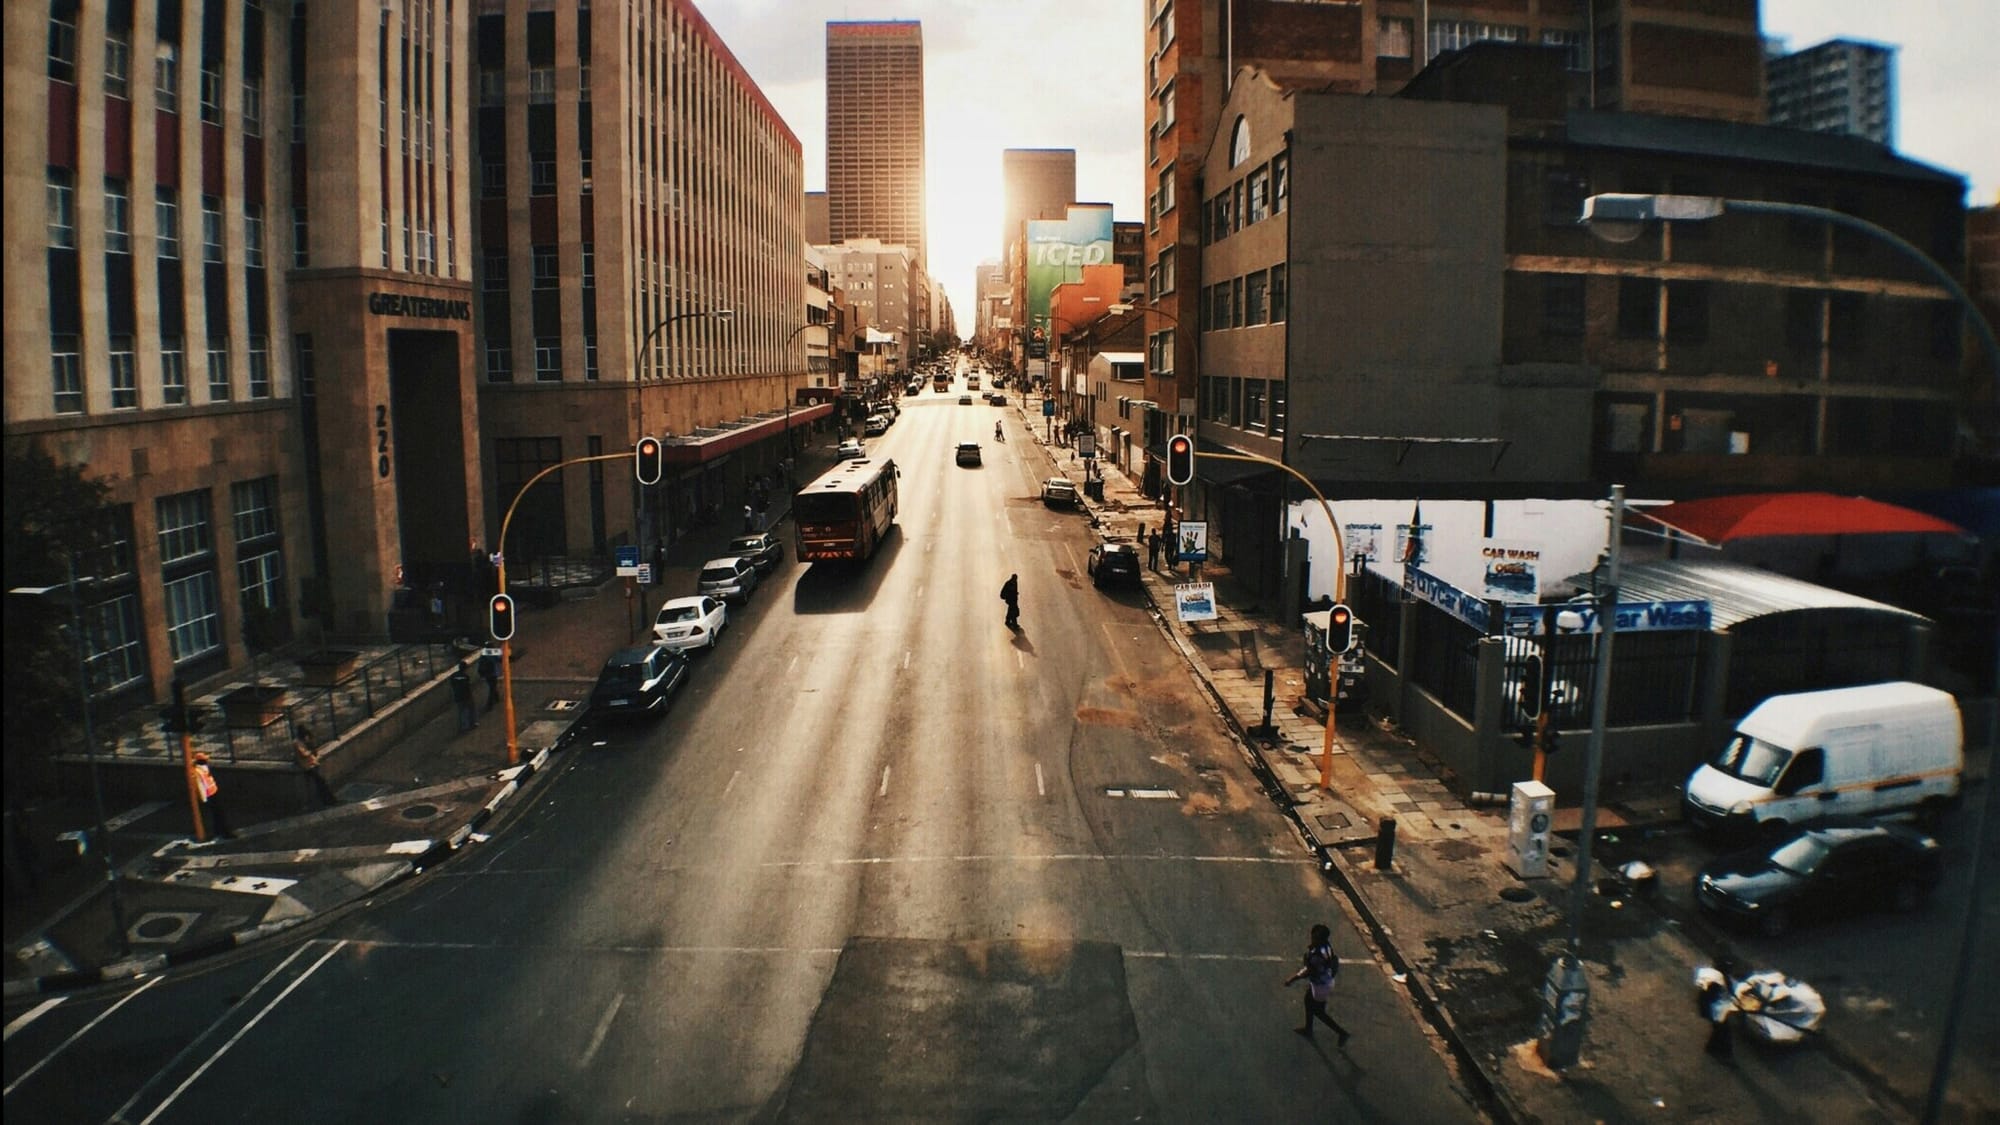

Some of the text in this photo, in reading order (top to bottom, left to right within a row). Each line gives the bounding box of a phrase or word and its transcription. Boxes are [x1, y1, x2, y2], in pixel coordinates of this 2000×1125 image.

[1035, 243, 1105, 266] ICED
[369, 293, 469, 320] GREATERMANS
[376, 405, 389, 478] 220
[1483, 547, 1540, 560] CAR WASH
[1647, 603, 1712, 627] Wash
